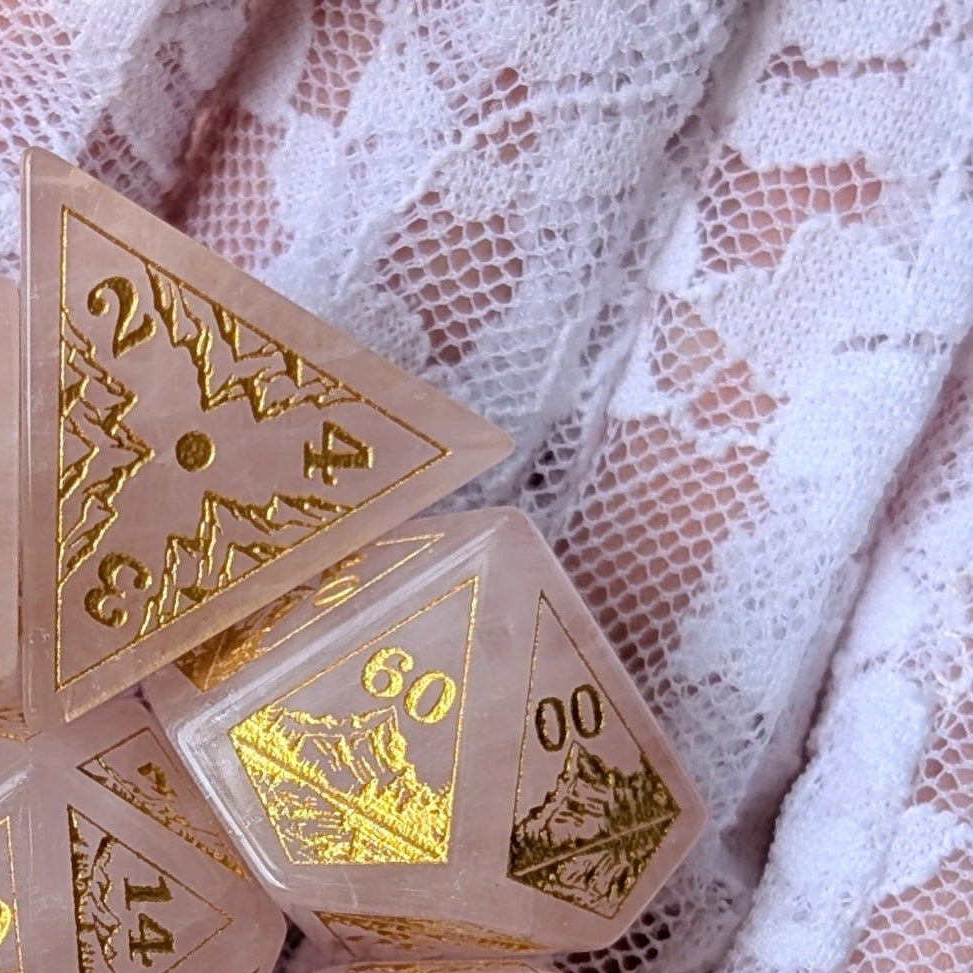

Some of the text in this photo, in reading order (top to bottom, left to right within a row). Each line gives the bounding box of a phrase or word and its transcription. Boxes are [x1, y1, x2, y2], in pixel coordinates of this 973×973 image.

[87, 276, 154, 358] 2
[304, 421, 374, 484] 4
[84, 551, 151, 627] 3
[360, 646, 457, 724] 60
[535, 683, 603, 751] 00
[124, 876, 175, 968] 14
